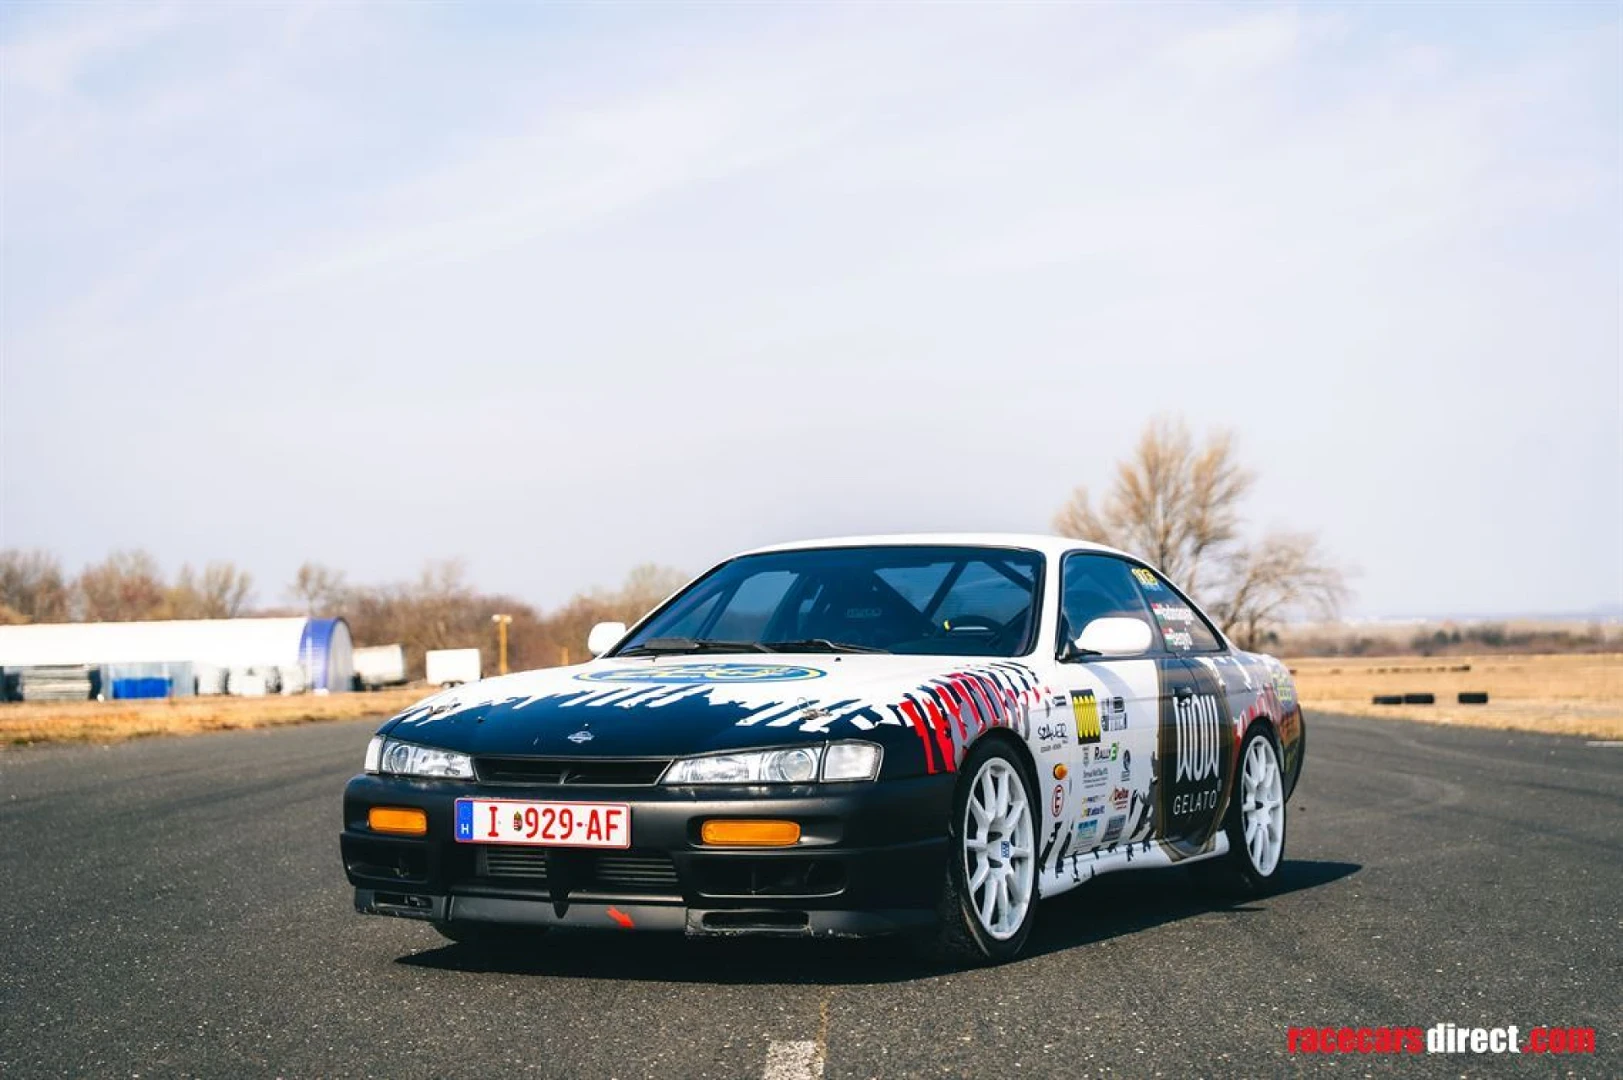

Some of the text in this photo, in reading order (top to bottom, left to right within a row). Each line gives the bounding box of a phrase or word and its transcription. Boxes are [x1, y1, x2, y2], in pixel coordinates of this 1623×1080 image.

[1173, 790, 1217, 815] GELATO
[461, 824, 470, 835] H
[525, 807, 622, 841] 929-AF
